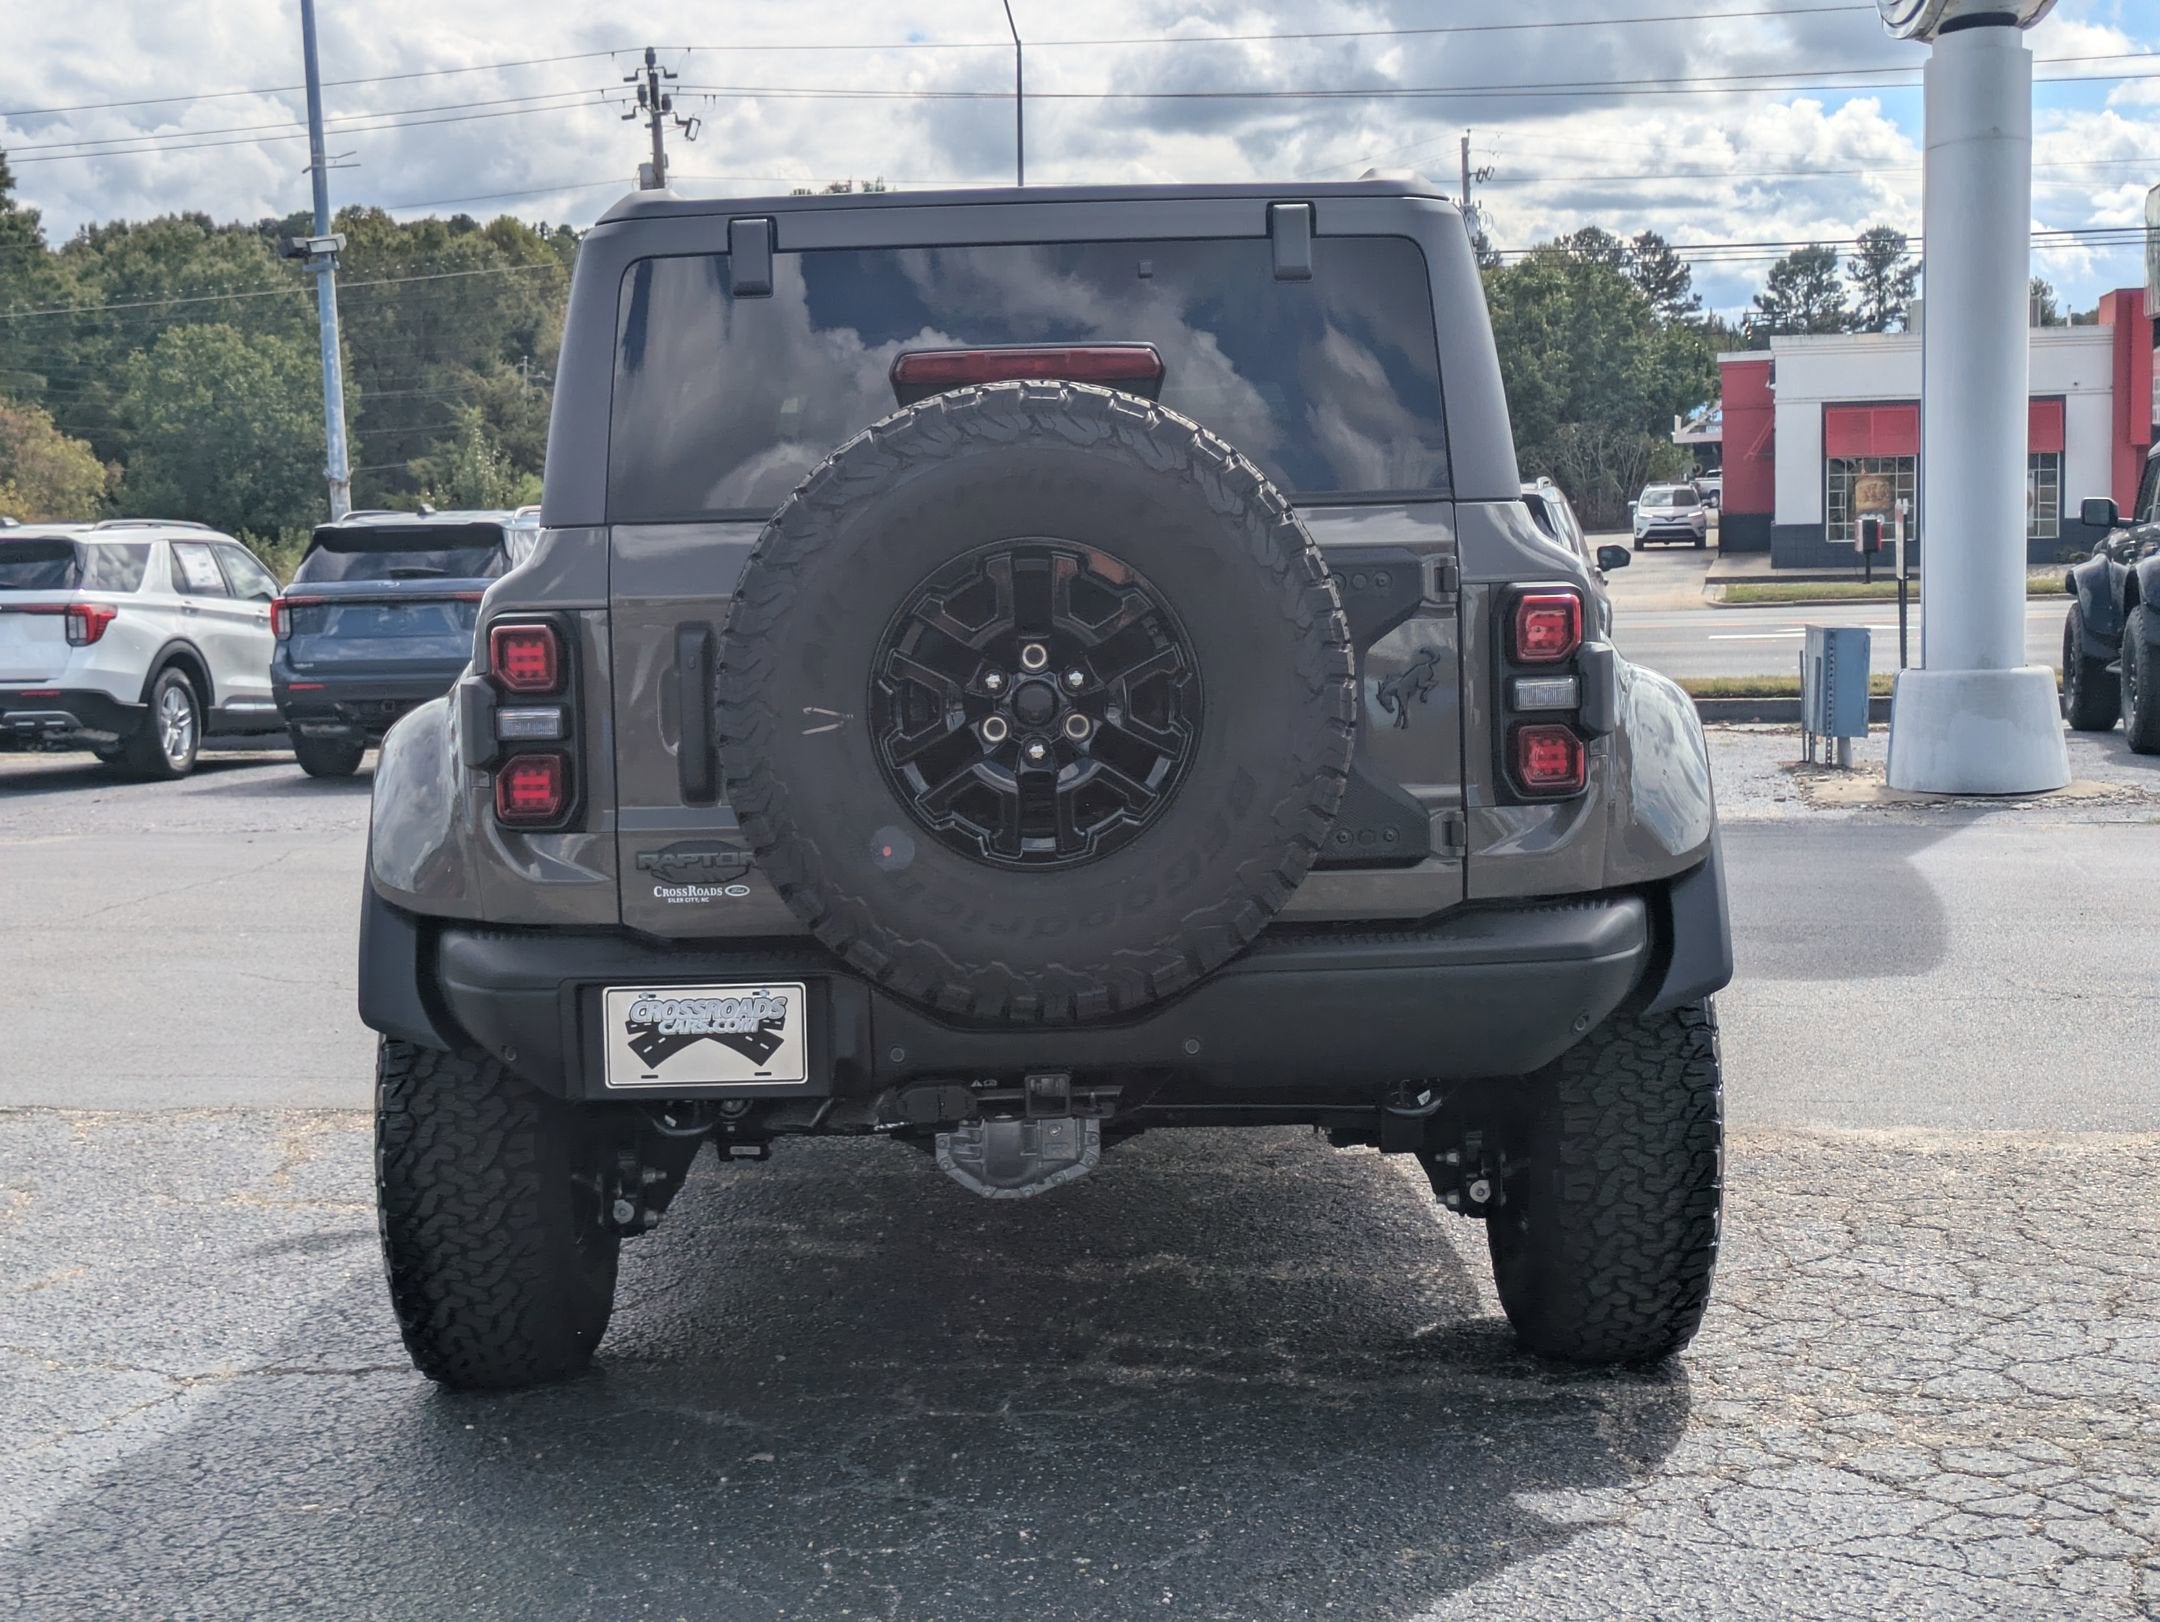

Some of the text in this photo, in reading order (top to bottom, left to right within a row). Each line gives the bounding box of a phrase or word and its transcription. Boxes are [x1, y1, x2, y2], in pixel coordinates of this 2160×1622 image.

[637, 852, 757, 869] RAPTOR
[629, 996, 788, 1023] CROSSROADS
[658, 1018, 760, 1035] CARS.COM
